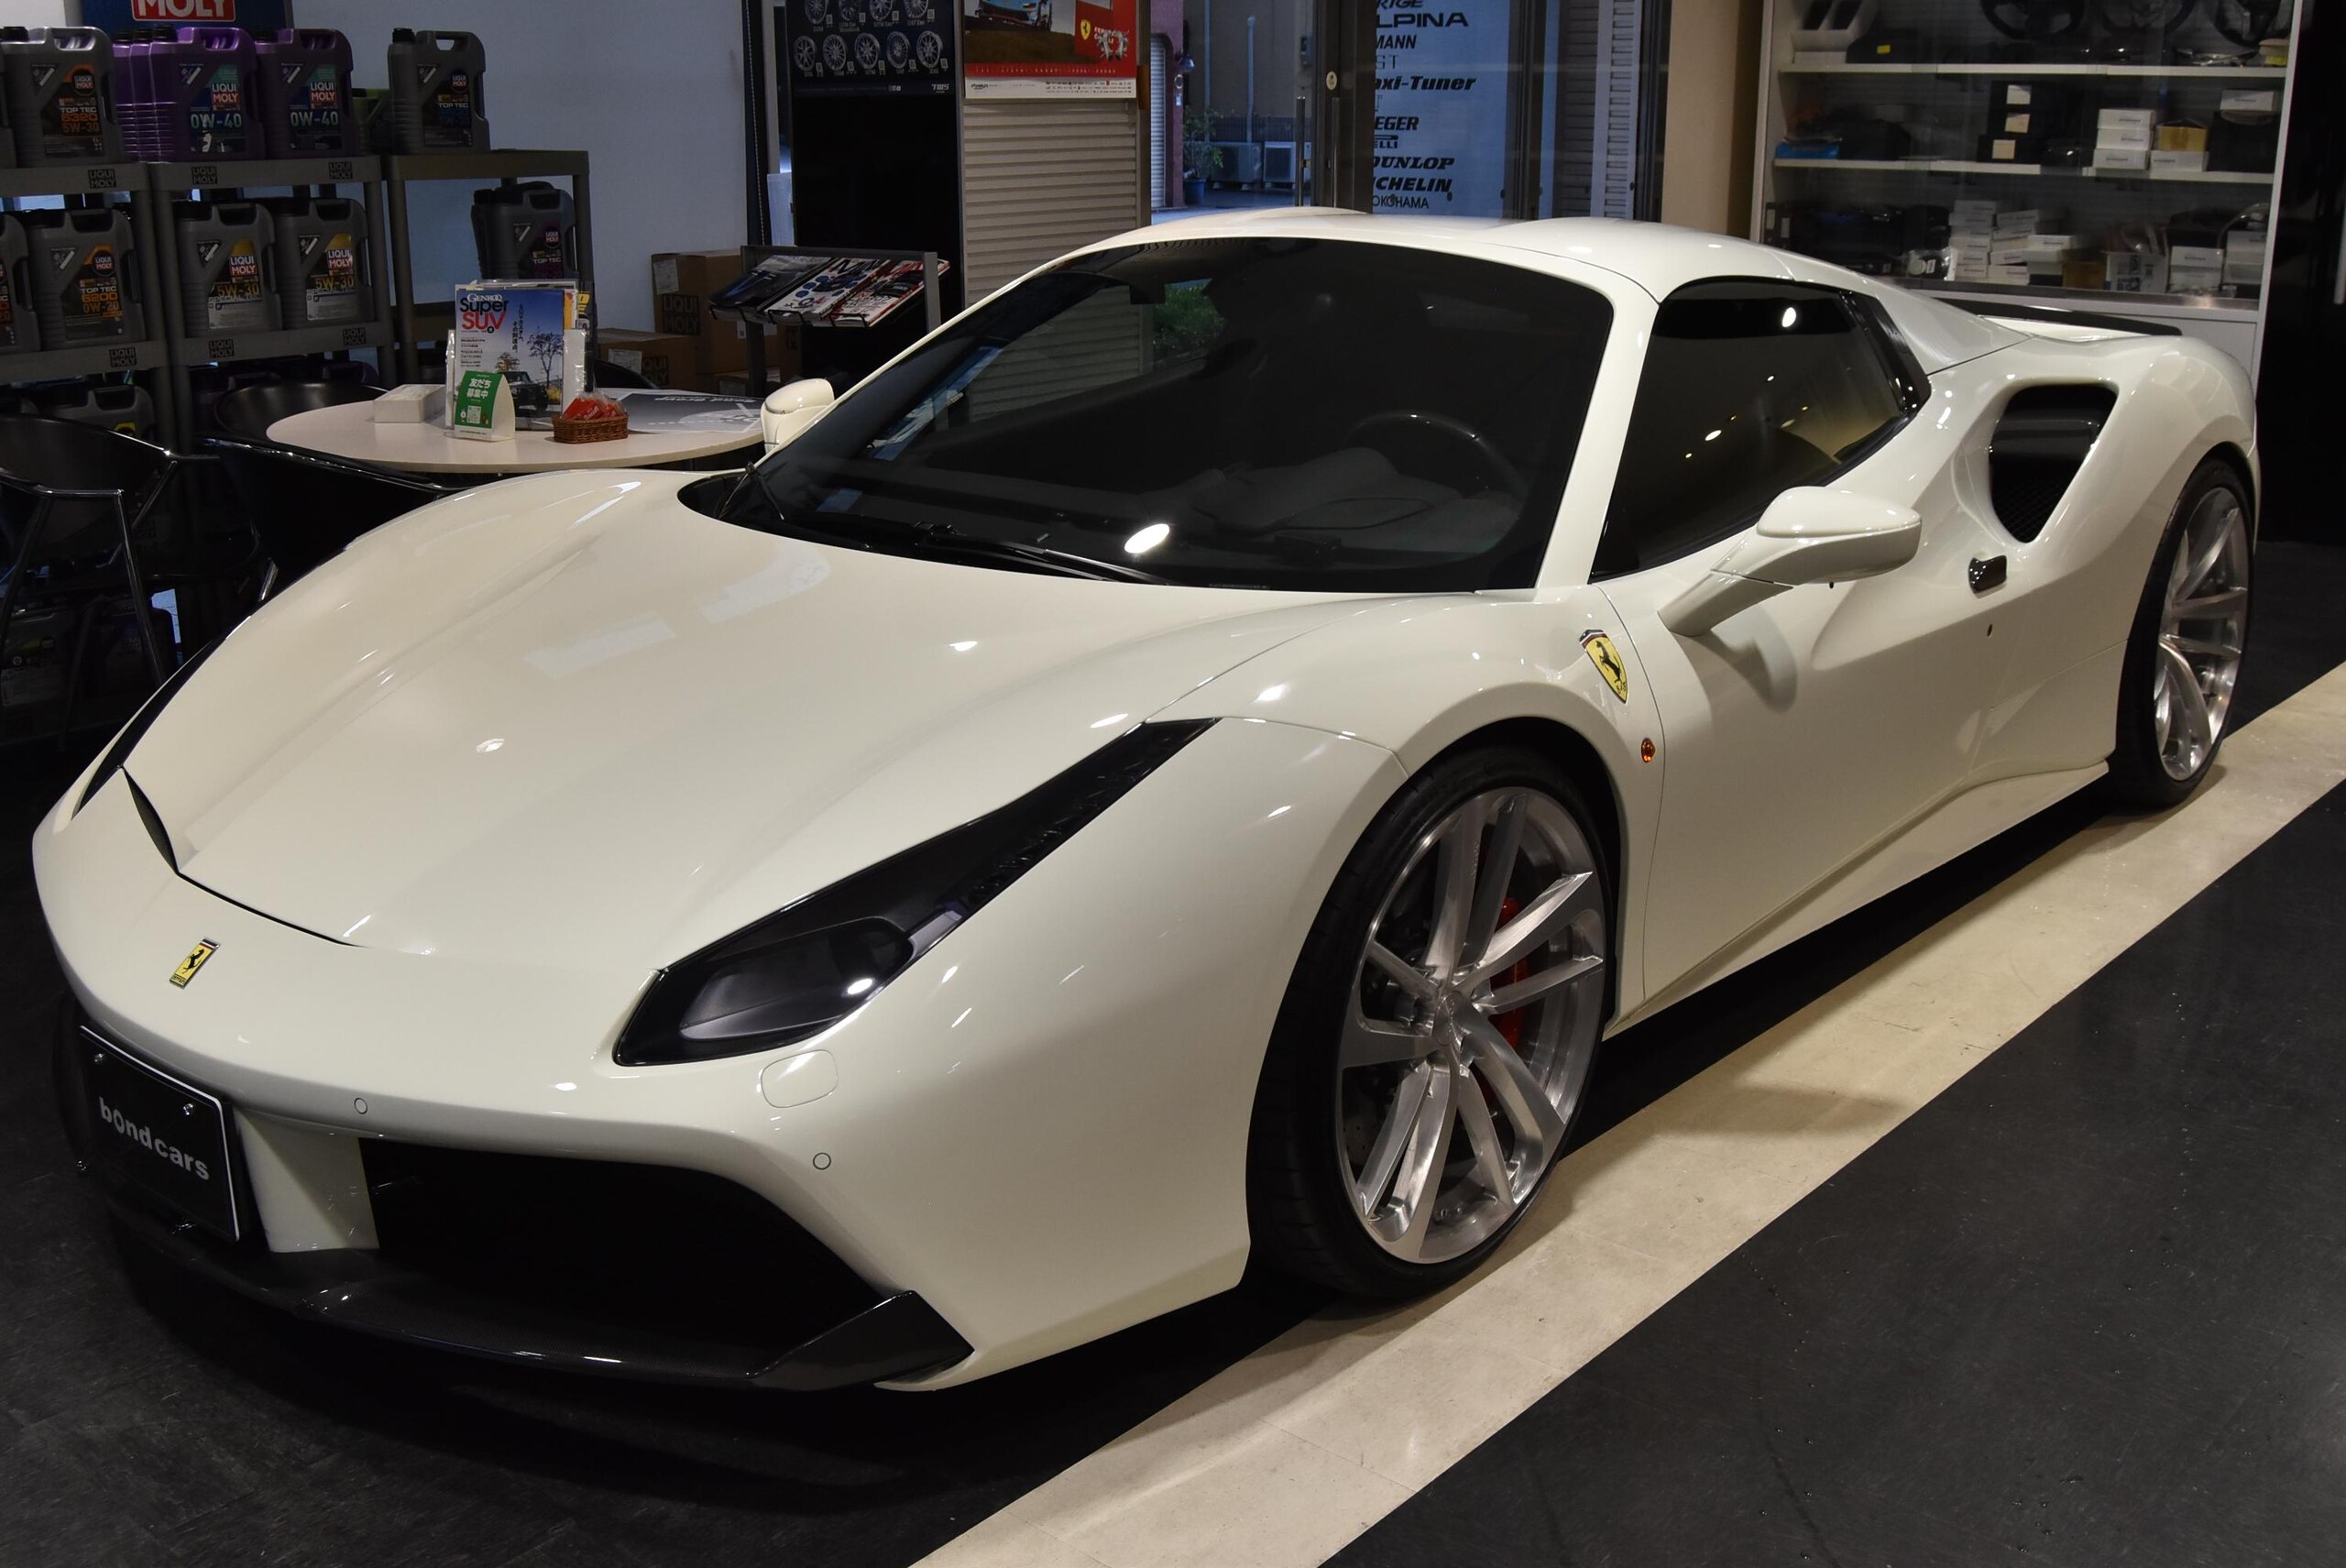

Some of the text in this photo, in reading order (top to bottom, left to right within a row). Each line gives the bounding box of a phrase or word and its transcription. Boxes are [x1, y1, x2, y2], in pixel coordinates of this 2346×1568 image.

[137, 0, 226, 17] MOLY
[1376, 12, 1469, 28] LPINA
[211, 82, 237, 93] LIQUI
[310, 82, 335, 92] LIQUI
[213, 92, 239, 104] MOLY
[311, 91, 337, 102] MOLY
[190, 113, 243, 129] 0W-40
[290, 111, 339, 126] 0W-40
[327, 248, 351, 258] LIQUI
[230, 255, 255, 266] LIQUI
[327, 258, 353, 269] MOLY
[231, 264, 258, 275] MOLY
[217, 282, 260, 297] 5W-30
[314, 276, 355, 291] 5W-30
[82, 292, 118, 302] 6200
[82, 301, 120, 314] 0W-20
[460, 297, 510, 316] Super
[663, 295, 699, 313] LIQUI
[461, 311, 507, 330] SUV
